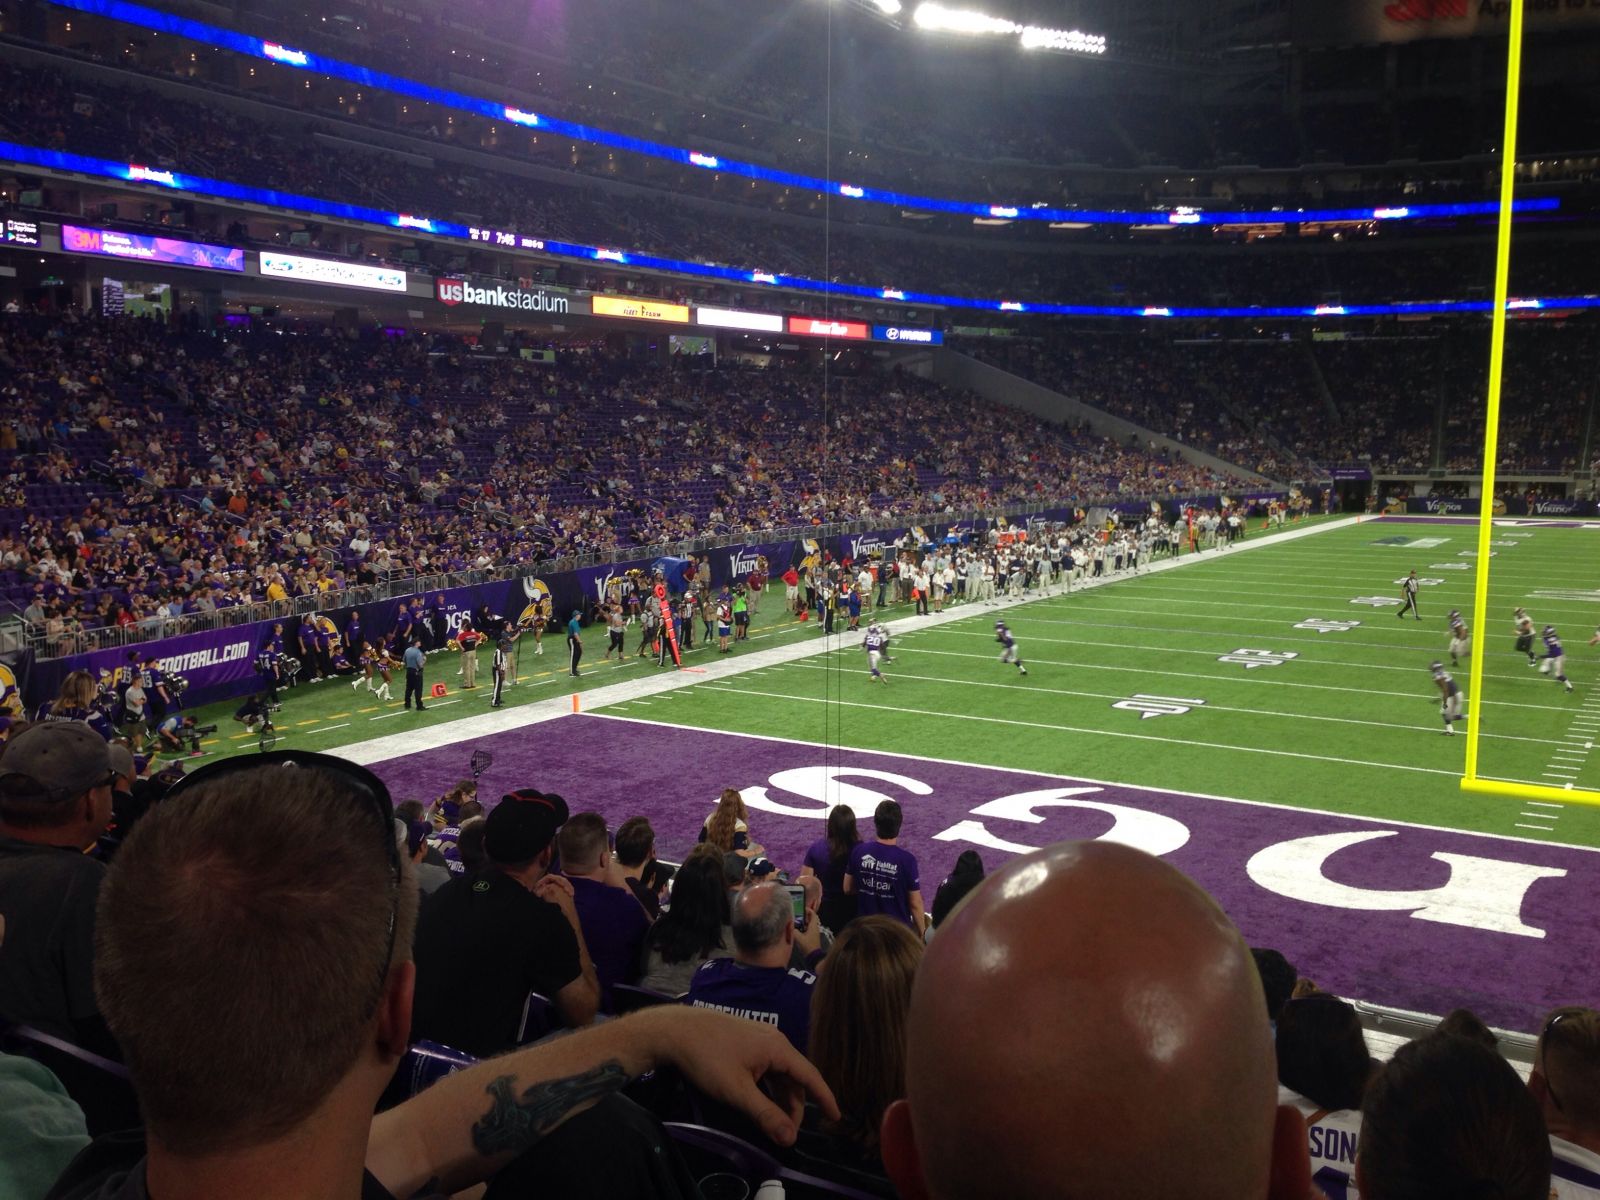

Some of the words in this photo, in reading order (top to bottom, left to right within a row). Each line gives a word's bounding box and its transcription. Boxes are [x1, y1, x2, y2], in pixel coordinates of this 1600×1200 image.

[74, 230, 100, 250] 3M
[192, 248, 237, 267] 3M.com
[867, 636, 881, 647] 20
[436, 685, 446, 696] G
[876, 861, 898, 871] Habitat
